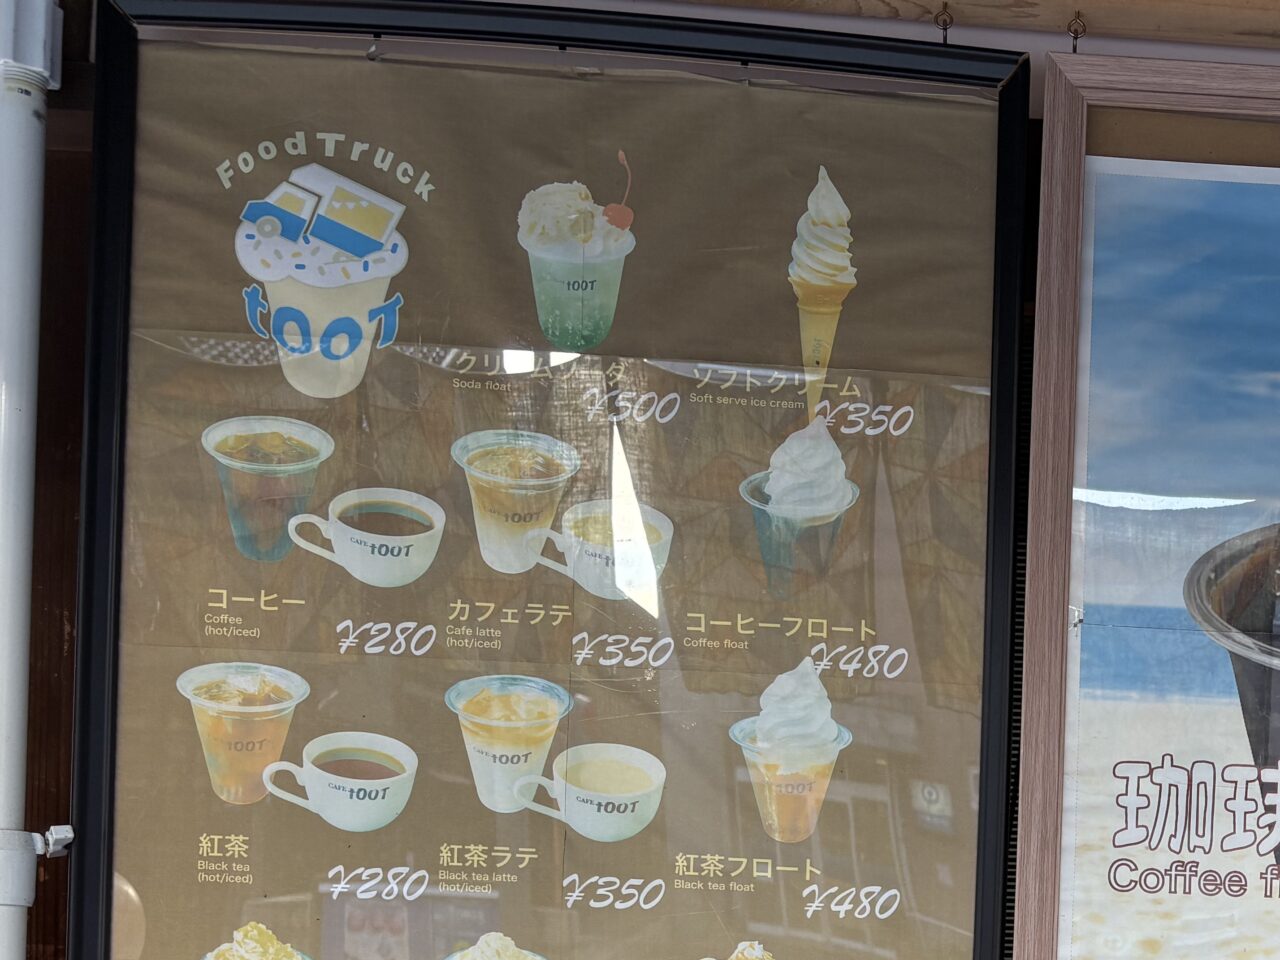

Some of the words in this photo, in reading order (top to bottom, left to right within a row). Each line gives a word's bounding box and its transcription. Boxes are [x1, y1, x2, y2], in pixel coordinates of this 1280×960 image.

[452, 377, 482, 390] Soda
[485, 380, 512, 392] float
[694, 364, 862, 399] ソフトクリーム
[580, 388, 682, 425] ¥500
[689, 392, 714, 404] Soft
[716, 396, 748, 406] serve
[750, 397, 766, 407] ice
[768, 399, 805, 409] cream
[813, 400, 914, 436] ¥350
[207, 588, 306, 611] コーヒー
[204, 614, 243, 626] Coffee
[448, 599, 572, 627] カフェラテ
[204, 625, 261, 638] (hot/iced)
[336, 620, 437, 656] ¥280
[446, 625, 473, 637] Cafe
[475, 627, 502, 638] latte
[686, 612, 877, 641] コーヒーフロート
[446, 637, 502, 650] (hot/iced)
[572, 632, 674, 667] ¥350
[683, 637, 722, 649] Coffee
[723, 638, 749, 650] float
[810, 643, 909, 680] ¥480
[199, 833, 250, 859] 紅茶
[439, 843, 539, 869] 紅茶ラテ
[197, 872, 253, 886] (hot/iced)
[198, 860, 229, 872] Black
[232, 862, 251, 873] tea
[438, 869, 468, 881] Black
[471, 872, 490, 882] tea
[492, 872, 518, 883] latte
[675, 852, 823, 882] 紅茶フロート
[1107, 858, 1249, 897] Coffee
[327, 865, 429, 902] ¥280
[438, 881, 492, 894] (hot/iced)
[562, 873, 666, 911] ¥350
[674, 879, 704, 891] Black
[708, 882, 726, 892] tea
[729, 881, 755, 893] float
[802, 884, 901, 920] ¥480
